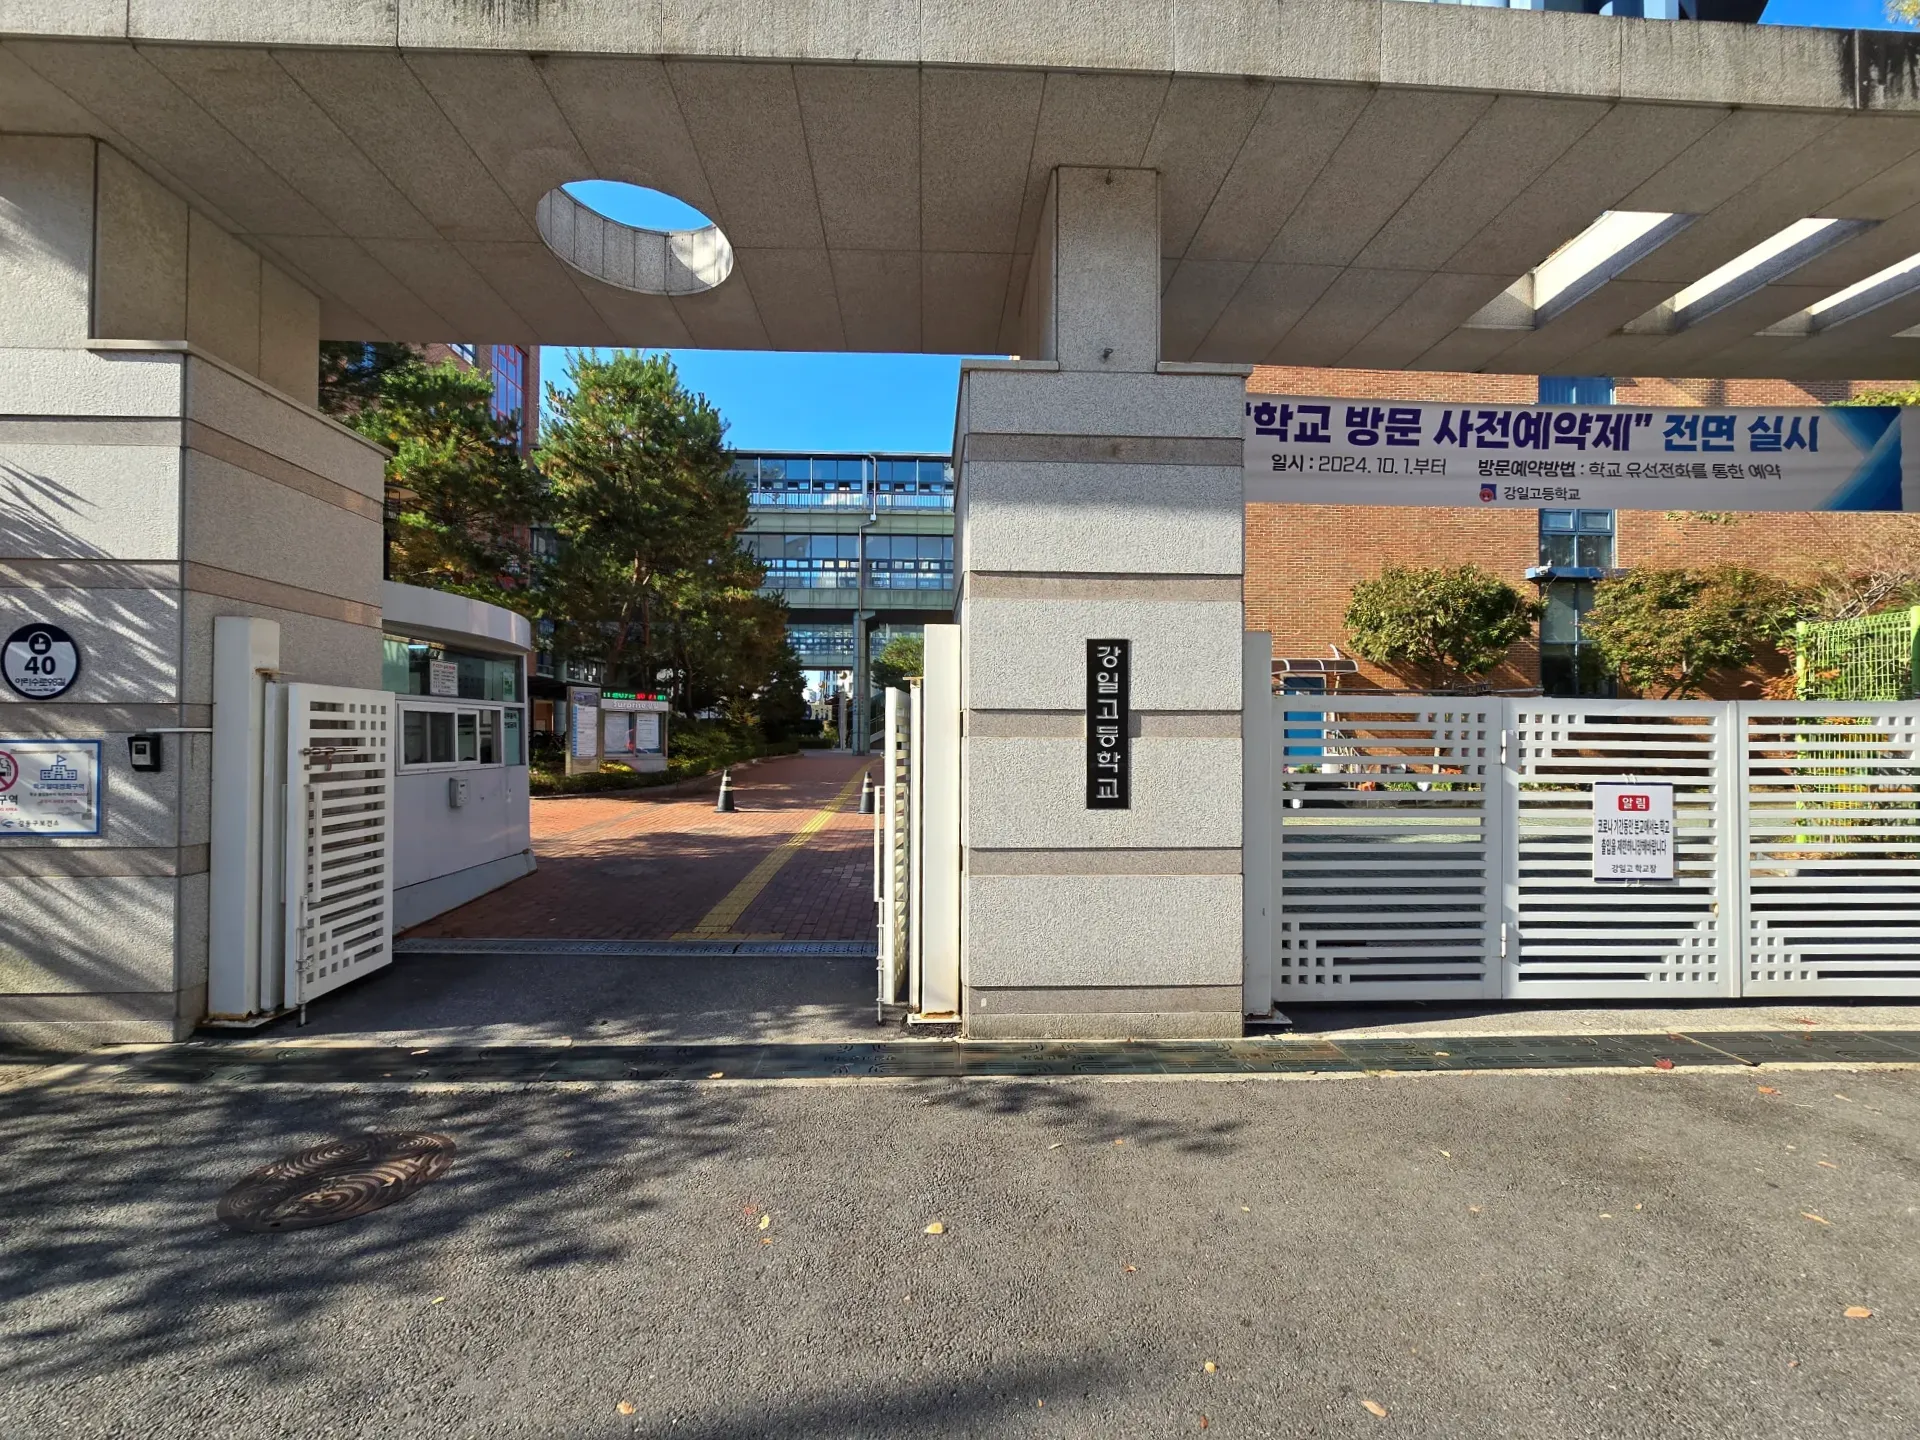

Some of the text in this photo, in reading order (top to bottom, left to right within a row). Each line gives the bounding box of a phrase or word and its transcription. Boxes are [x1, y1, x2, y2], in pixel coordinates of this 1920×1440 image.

[1345, 406, 1423, 447] 방문
[1662, 414, 1738, 453] 전면
[1747, 415, 1821, 453] 실시
[1271, 454, 1304, 472] 일시
[1318, 455, 1372, 474] 2024.
[1377, 457, 1399, 474] 10.
[1478, 459, 1576, 478] 방문예약방법
[1588, 461, 1622, 478] 학교
[1626, 462, 1709, 480] 유선전화를
[1712, 463, 1745, 480] 통한
[1748, 463, 1782, 480] 예약
[1503, 485, 1582, 501] 강일고등학교
[24, 655, 56, 675] 40
[1095, 645, 1122, 800] 강일고등학교
[1598, 819, 1613, 835] 코로나
[1611, 863, 1657, 874] 강일고 학교장
